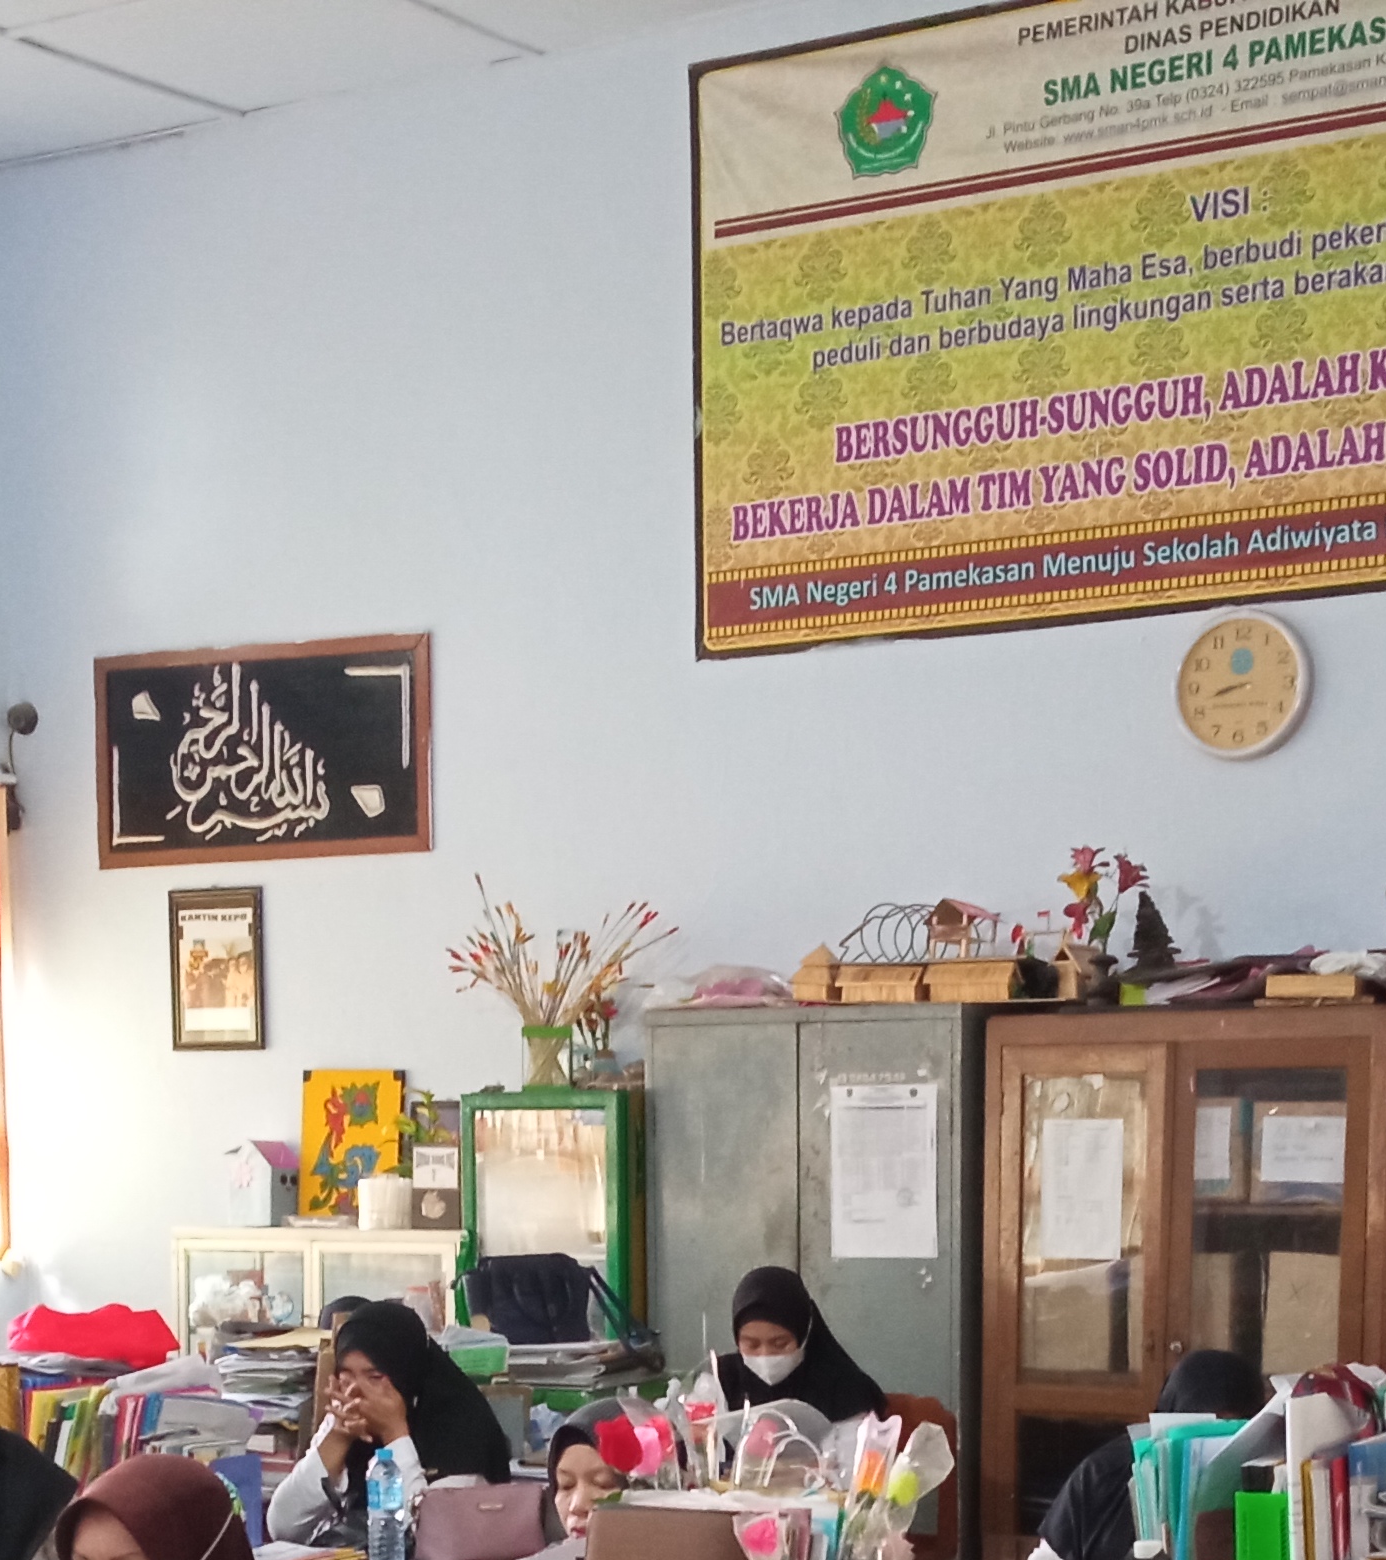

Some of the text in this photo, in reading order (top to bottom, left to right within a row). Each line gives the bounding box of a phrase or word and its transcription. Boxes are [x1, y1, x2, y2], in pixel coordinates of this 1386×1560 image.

[1017, 4, 1158, 46] PEMERINTAH
[1124, 0, 1340, 54] DINAS PENDIDIKAN
[1003, 121, 1035, 135] Pintu
[1040, 109, 1095, 129] Gerbang
[1127, 96, 1150, 112] 39a
[1186, 85, 1230, 103] (0324)
[1234, 72, 1284, 92] 322595
[1289, 58, 1371, 82] Pamekasan
[1043, 72, 1101, 106] SMA
[1109, 49, 1213, 94] NEGERI
[1222, 44, 1239, 71] 4
[1190, 186, 1250, 222] VISI
[721, 313, 824, 346] Bertaqwa
[831, 296, 912, 331] kepada
[920, 286, 991, 314] Tuhan
[1000, 275, 1058, 302] Yang
[1067, 261, 1132, 292] Maha
[1141, 252, 1193, 281] Esa,
[1203, 230, 1302, 270] berbudi
[813, 336, 880, 373] peduli
[889, 332, 931, 357] dan
[939, 315, 1064, 350] berbudaya
[1073, 289, 1212, 332] lingkungan
[1221, 276, 1284, 307] serta
[835, 375, 1212, 464] BERSUNGGUH-SUNGGUH,
[1218, 352, 1361, 411] ADALAH
[732, 490, 860, 542] BEKERJA
[867, 476, 970, 526] DALAM
[977, 468, 1031, 511] TIM
[1039, 456, 1126, 504] YANG
[1133, 442, 1236, 492] SOLID,
[1244, 420, 1386, 478] ADALAH
[749, 583, 800, 611] SMA
[807, 573, 877, 607] Negeri
[884, 572, 898, 595] 4
[905, 562, 1034, 594] Pamekasan
[1043, 545, 1135, 578] Menuju
[1143, 532, 1239, 567] Sekolah
[1247, 519, 1377, 555] Adiwiyata
[1235, 627, 1252, 641] 12
[1188, 682, 1200, 695] 9
[1195, 657, 1210, 672] 10
[1212, 724, 1222, 738] 7
[1233, 729, 1244, 743] 6
